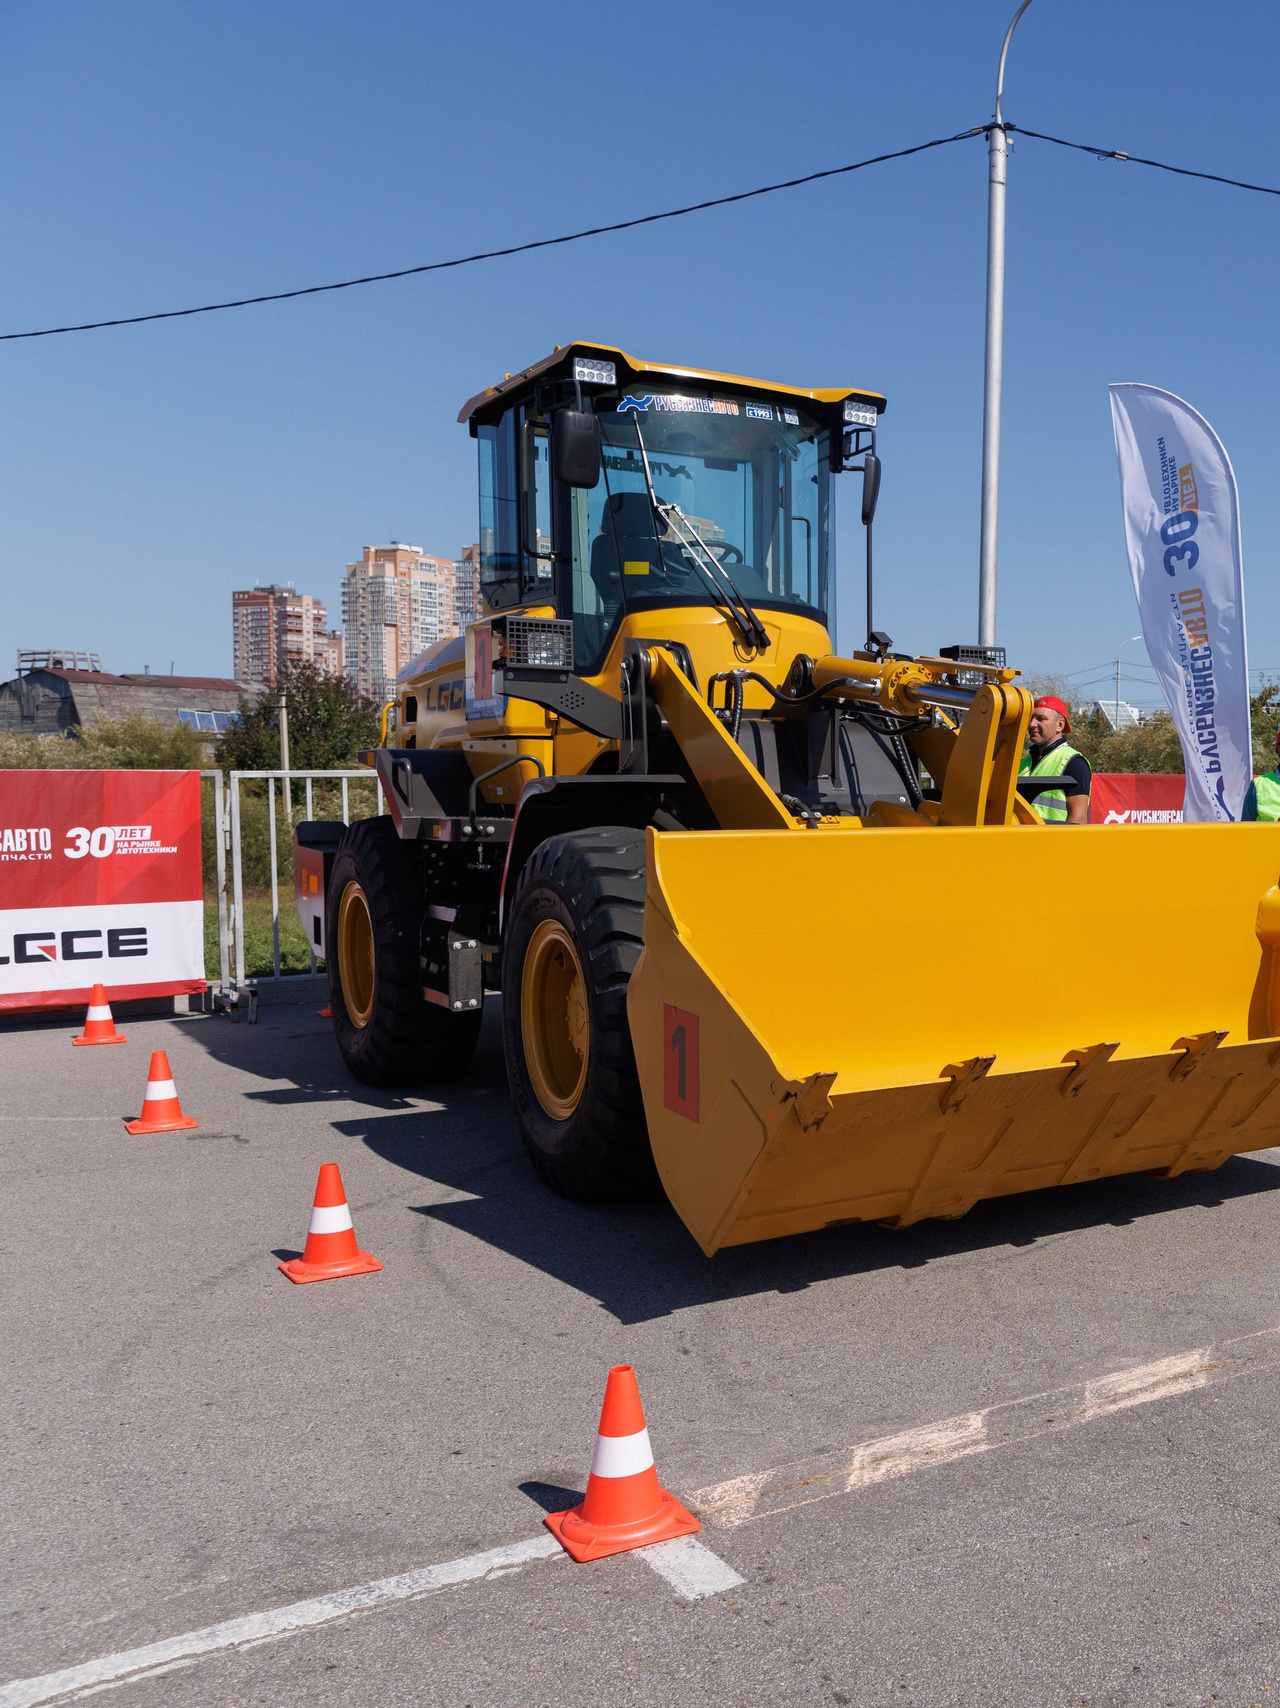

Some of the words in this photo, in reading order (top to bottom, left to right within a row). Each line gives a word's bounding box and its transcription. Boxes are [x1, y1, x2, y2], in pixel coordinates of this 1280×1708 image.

[754, 410, 770, 418] 1993
[426, 679, 467, 712] LGC
[0, 828, 52, 852] АВТО
[64, 826, 115, 859] 30
[118, 828, 147, 839] ЛЕТ
[116, 847, 178, 855] АВТОТЕХНИКИ
[131, 840, 161, 848] РЫНКЕ
[0, 927, 149, 965] GCE
[672, 1024, 687, 1101] 1
